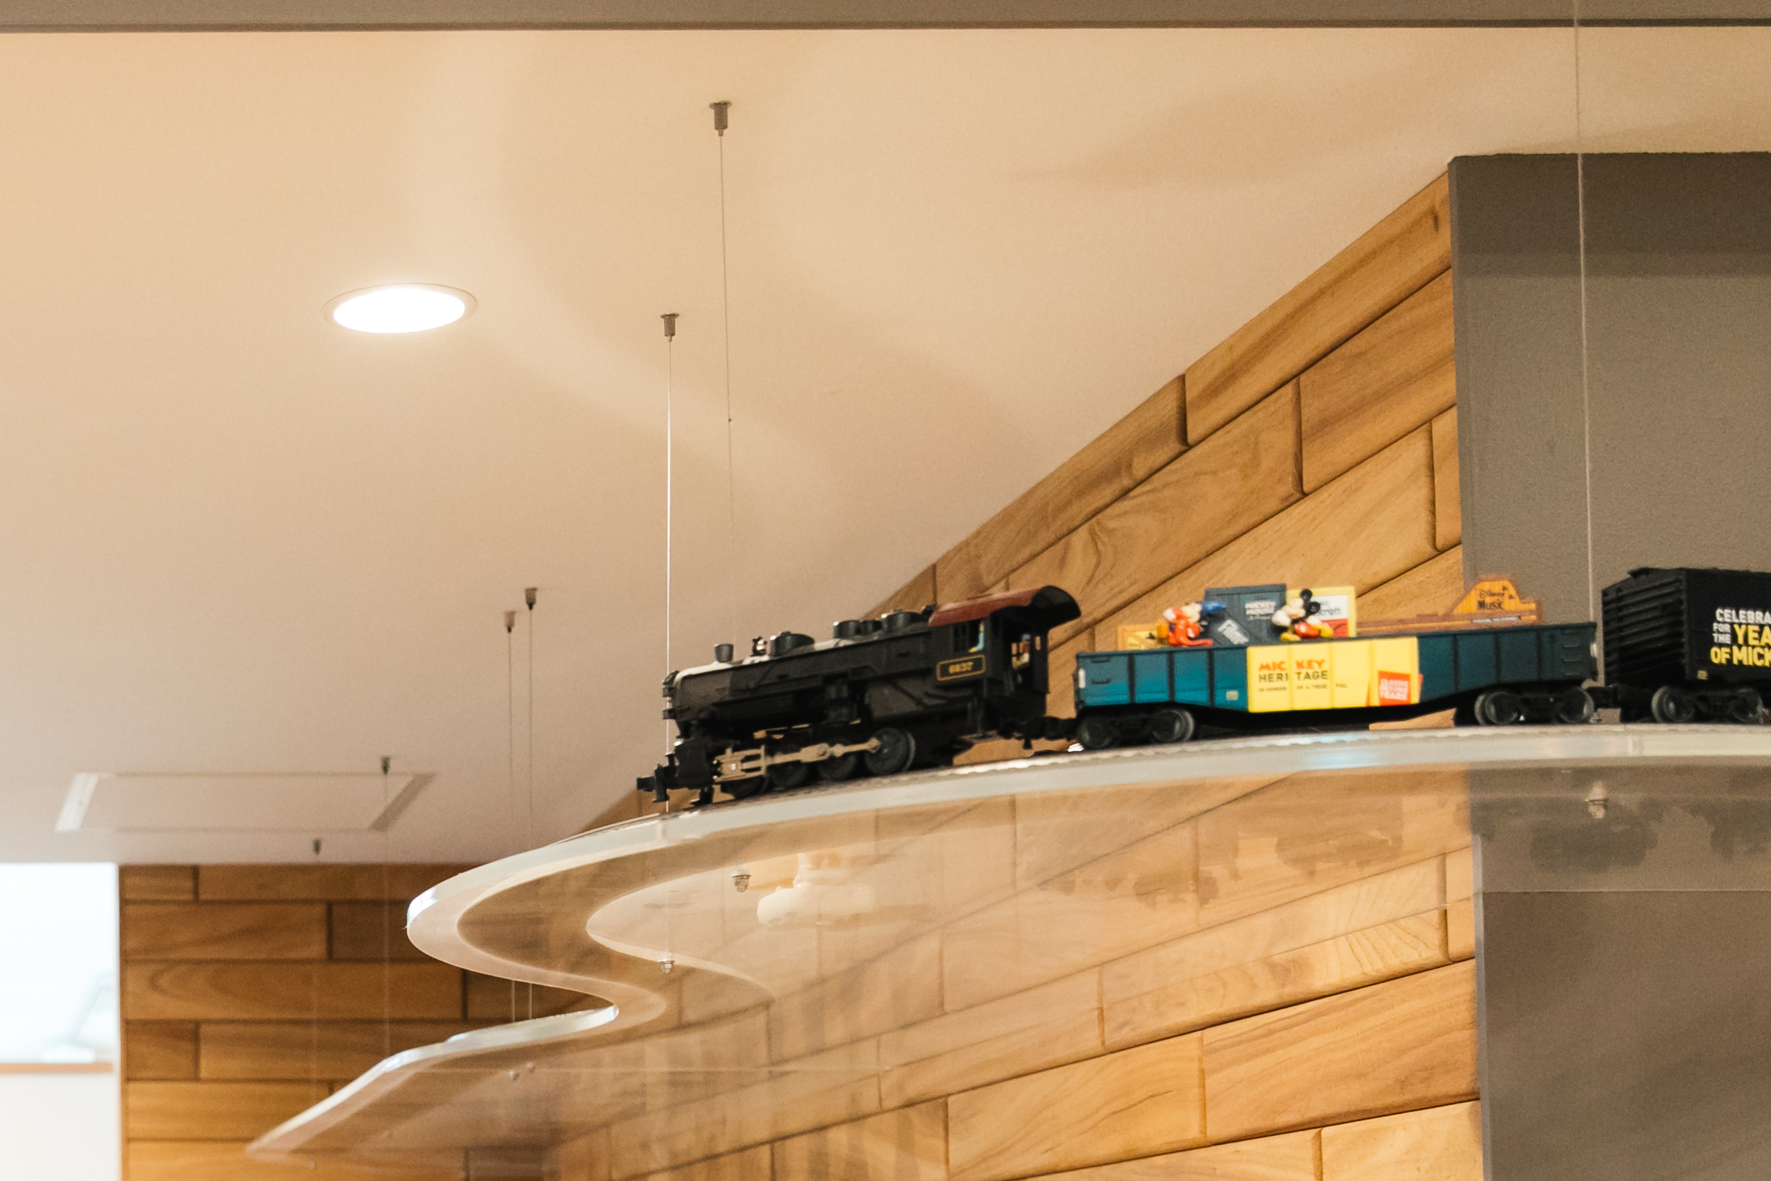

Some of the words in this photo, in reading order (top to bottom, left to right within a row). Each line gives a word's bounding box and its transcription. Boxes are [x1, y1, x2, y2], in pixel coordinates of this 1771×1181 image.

[1712, 622, 1731, 633] FOR
[1712, 633, 1731, 644] THE
[1710, 646, 1731, 665] OF
